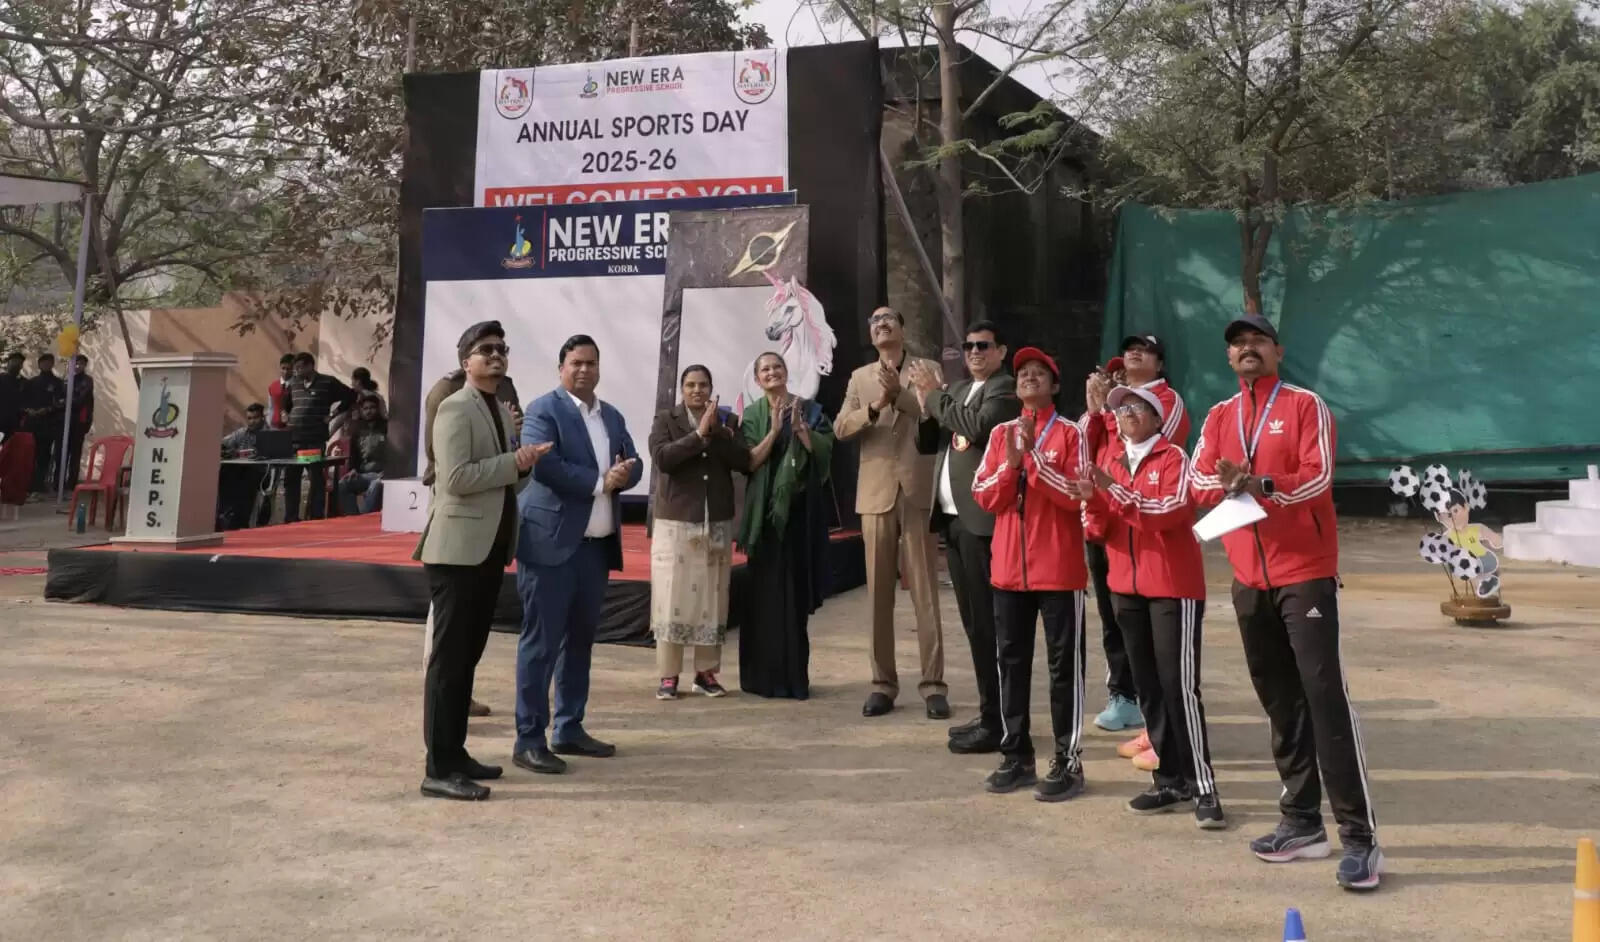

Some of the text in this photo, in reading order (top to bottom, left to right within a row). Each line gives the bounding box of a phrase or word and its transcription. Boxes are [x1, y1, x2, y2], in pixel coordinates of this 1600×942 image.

[606, 66, 685, 87] NEW ERA
[516, 109, 749, 144] ANNUAL SPORTS DAY
[581, 148, 677, 173] 2025-26
[548, 211, 670, 248] NEW ER
[548, 246, 641, 262] PROGRESSIVE
[607, 264, 639, 274] KORBA
[408, 490, 418, 510] 2
